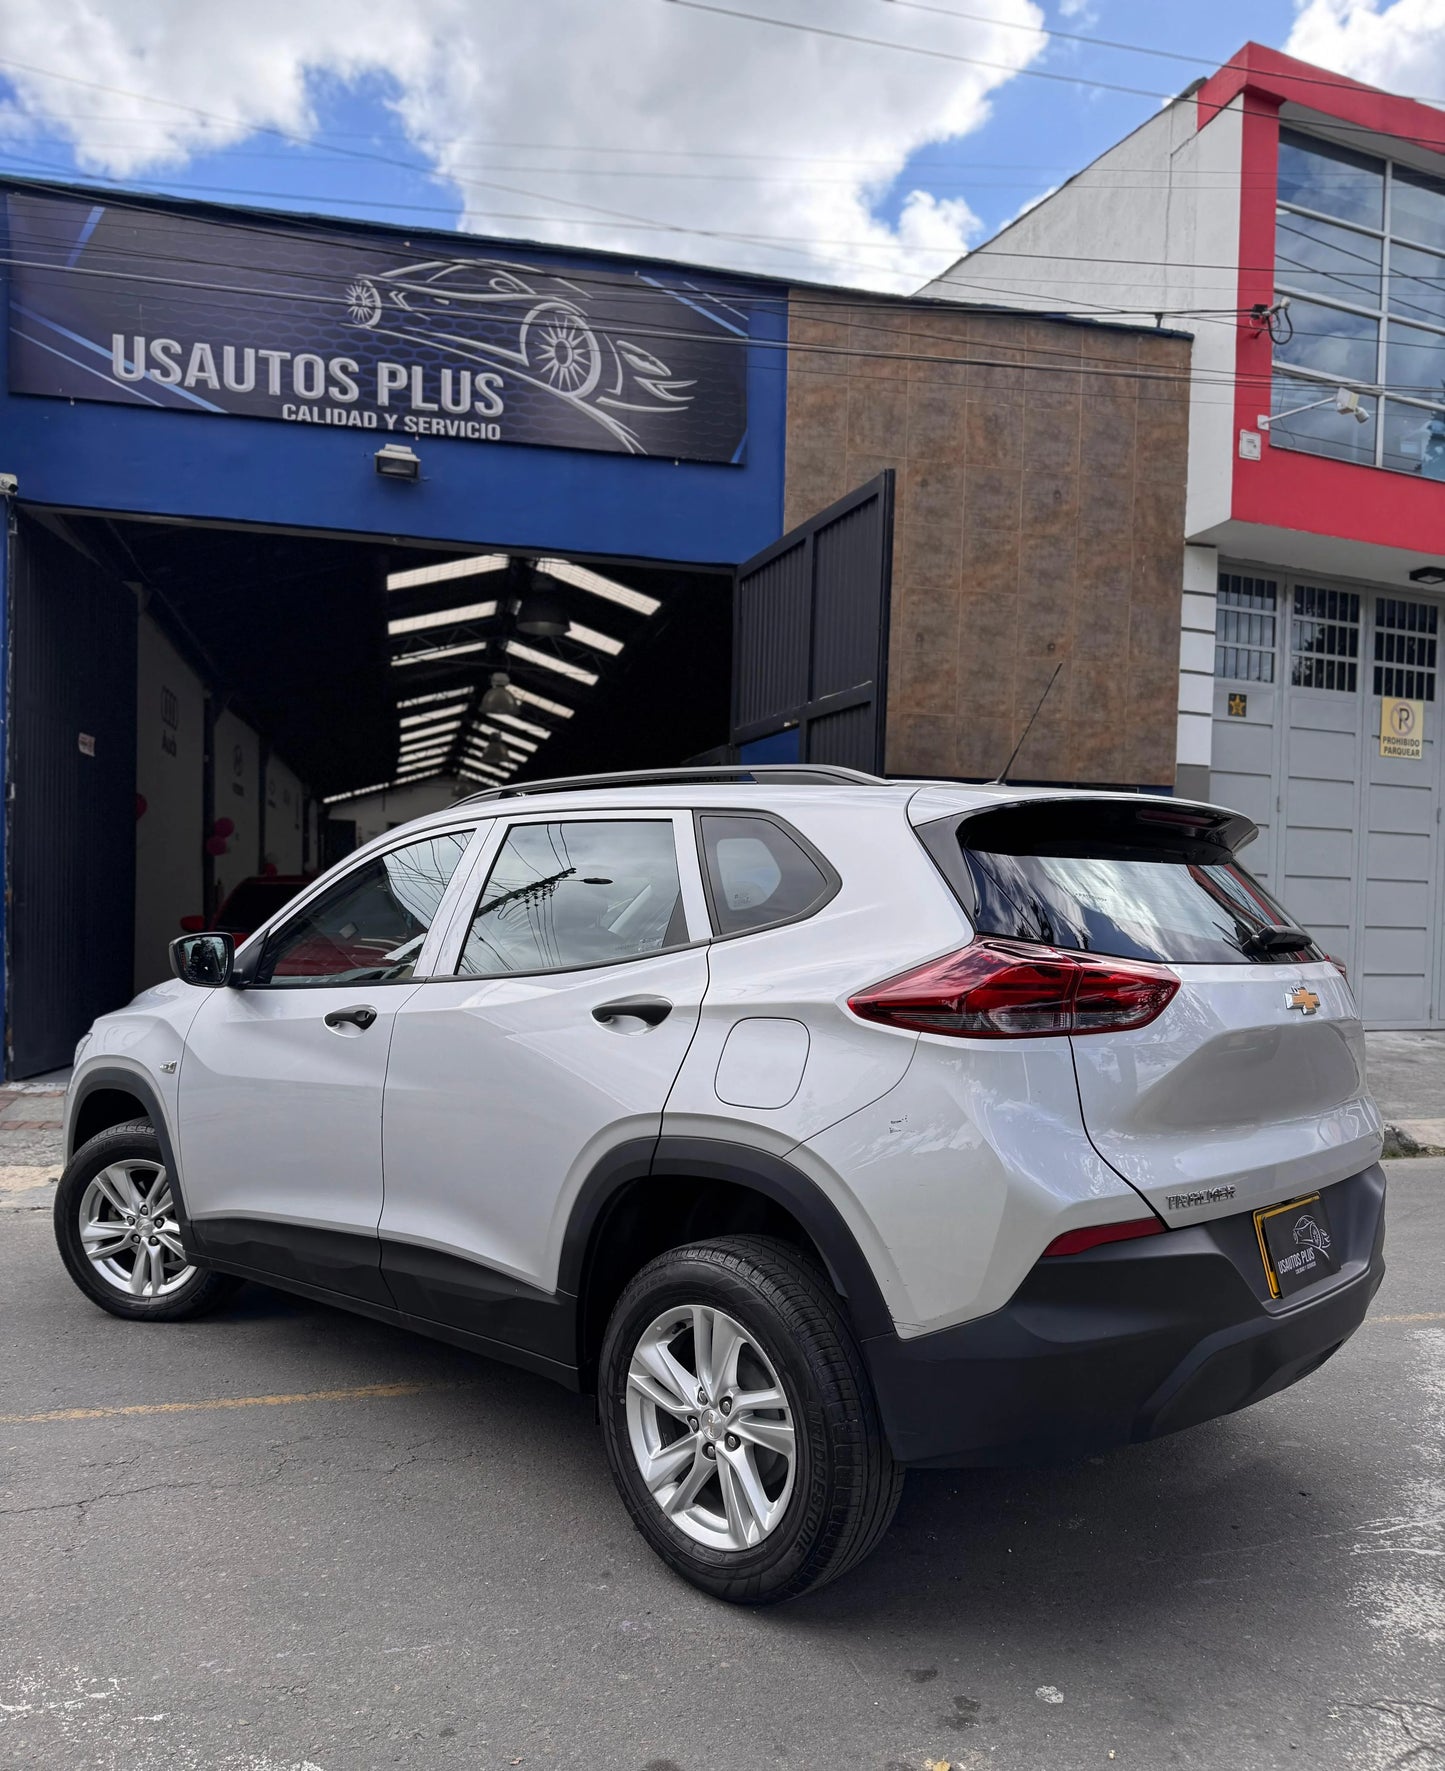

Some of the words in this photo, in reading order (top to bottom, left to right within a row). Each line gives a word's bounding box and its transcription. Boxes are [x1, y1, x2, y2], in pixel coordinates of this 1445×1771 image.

[112, 333, 360, 403] USAUTOS
[377, 362, 504, 417] PLUS
[282, 404, 378, 428] CALIDAD
[384, 413, 398, 430] Y
[404, 415, 501, 441] SERVICIO
[1398, 707, 1410, 730] P
[1382, 736, 1420, 747] PROHIBIDO
[1383, 746, 1420, 757] PARQUEAR
[1278, 1252, 1302, 1274] USAUTOS
[1300, 1246, 1316, 1264] PLUS
